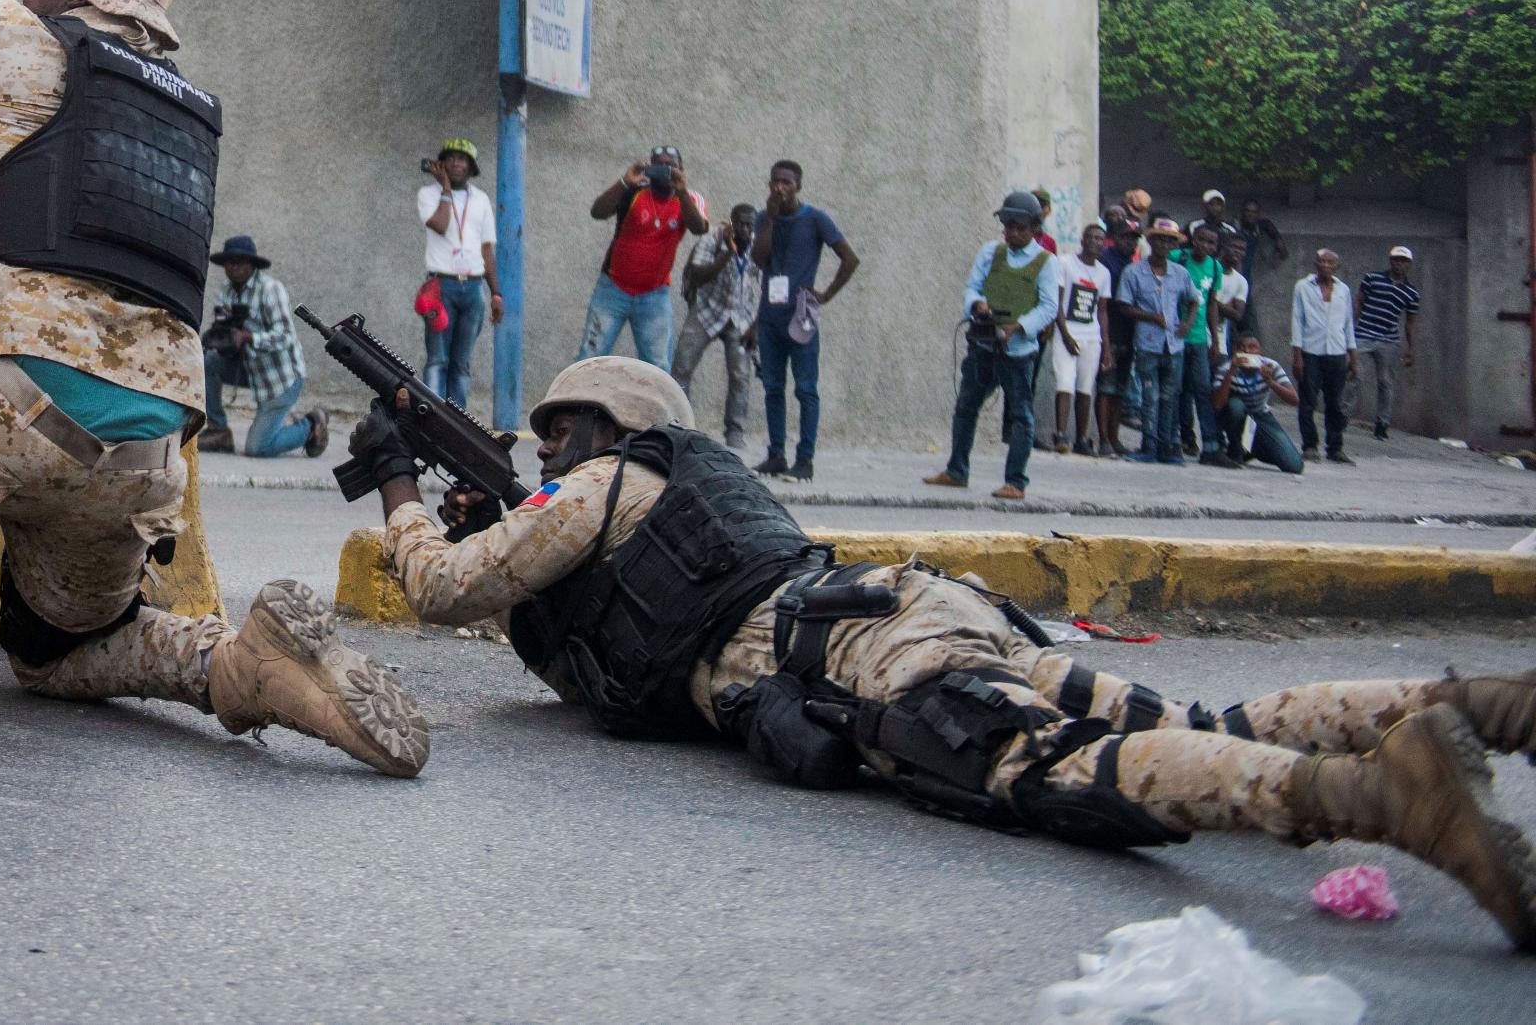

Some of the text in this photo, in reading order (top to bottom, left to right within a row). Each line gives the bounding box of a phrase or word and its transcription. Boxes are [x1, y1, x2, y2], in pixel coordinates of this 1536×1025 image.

[100, 40, 215, 107] POLICE NATIONALE
[142, 65, 183, 99] D'HAITI
